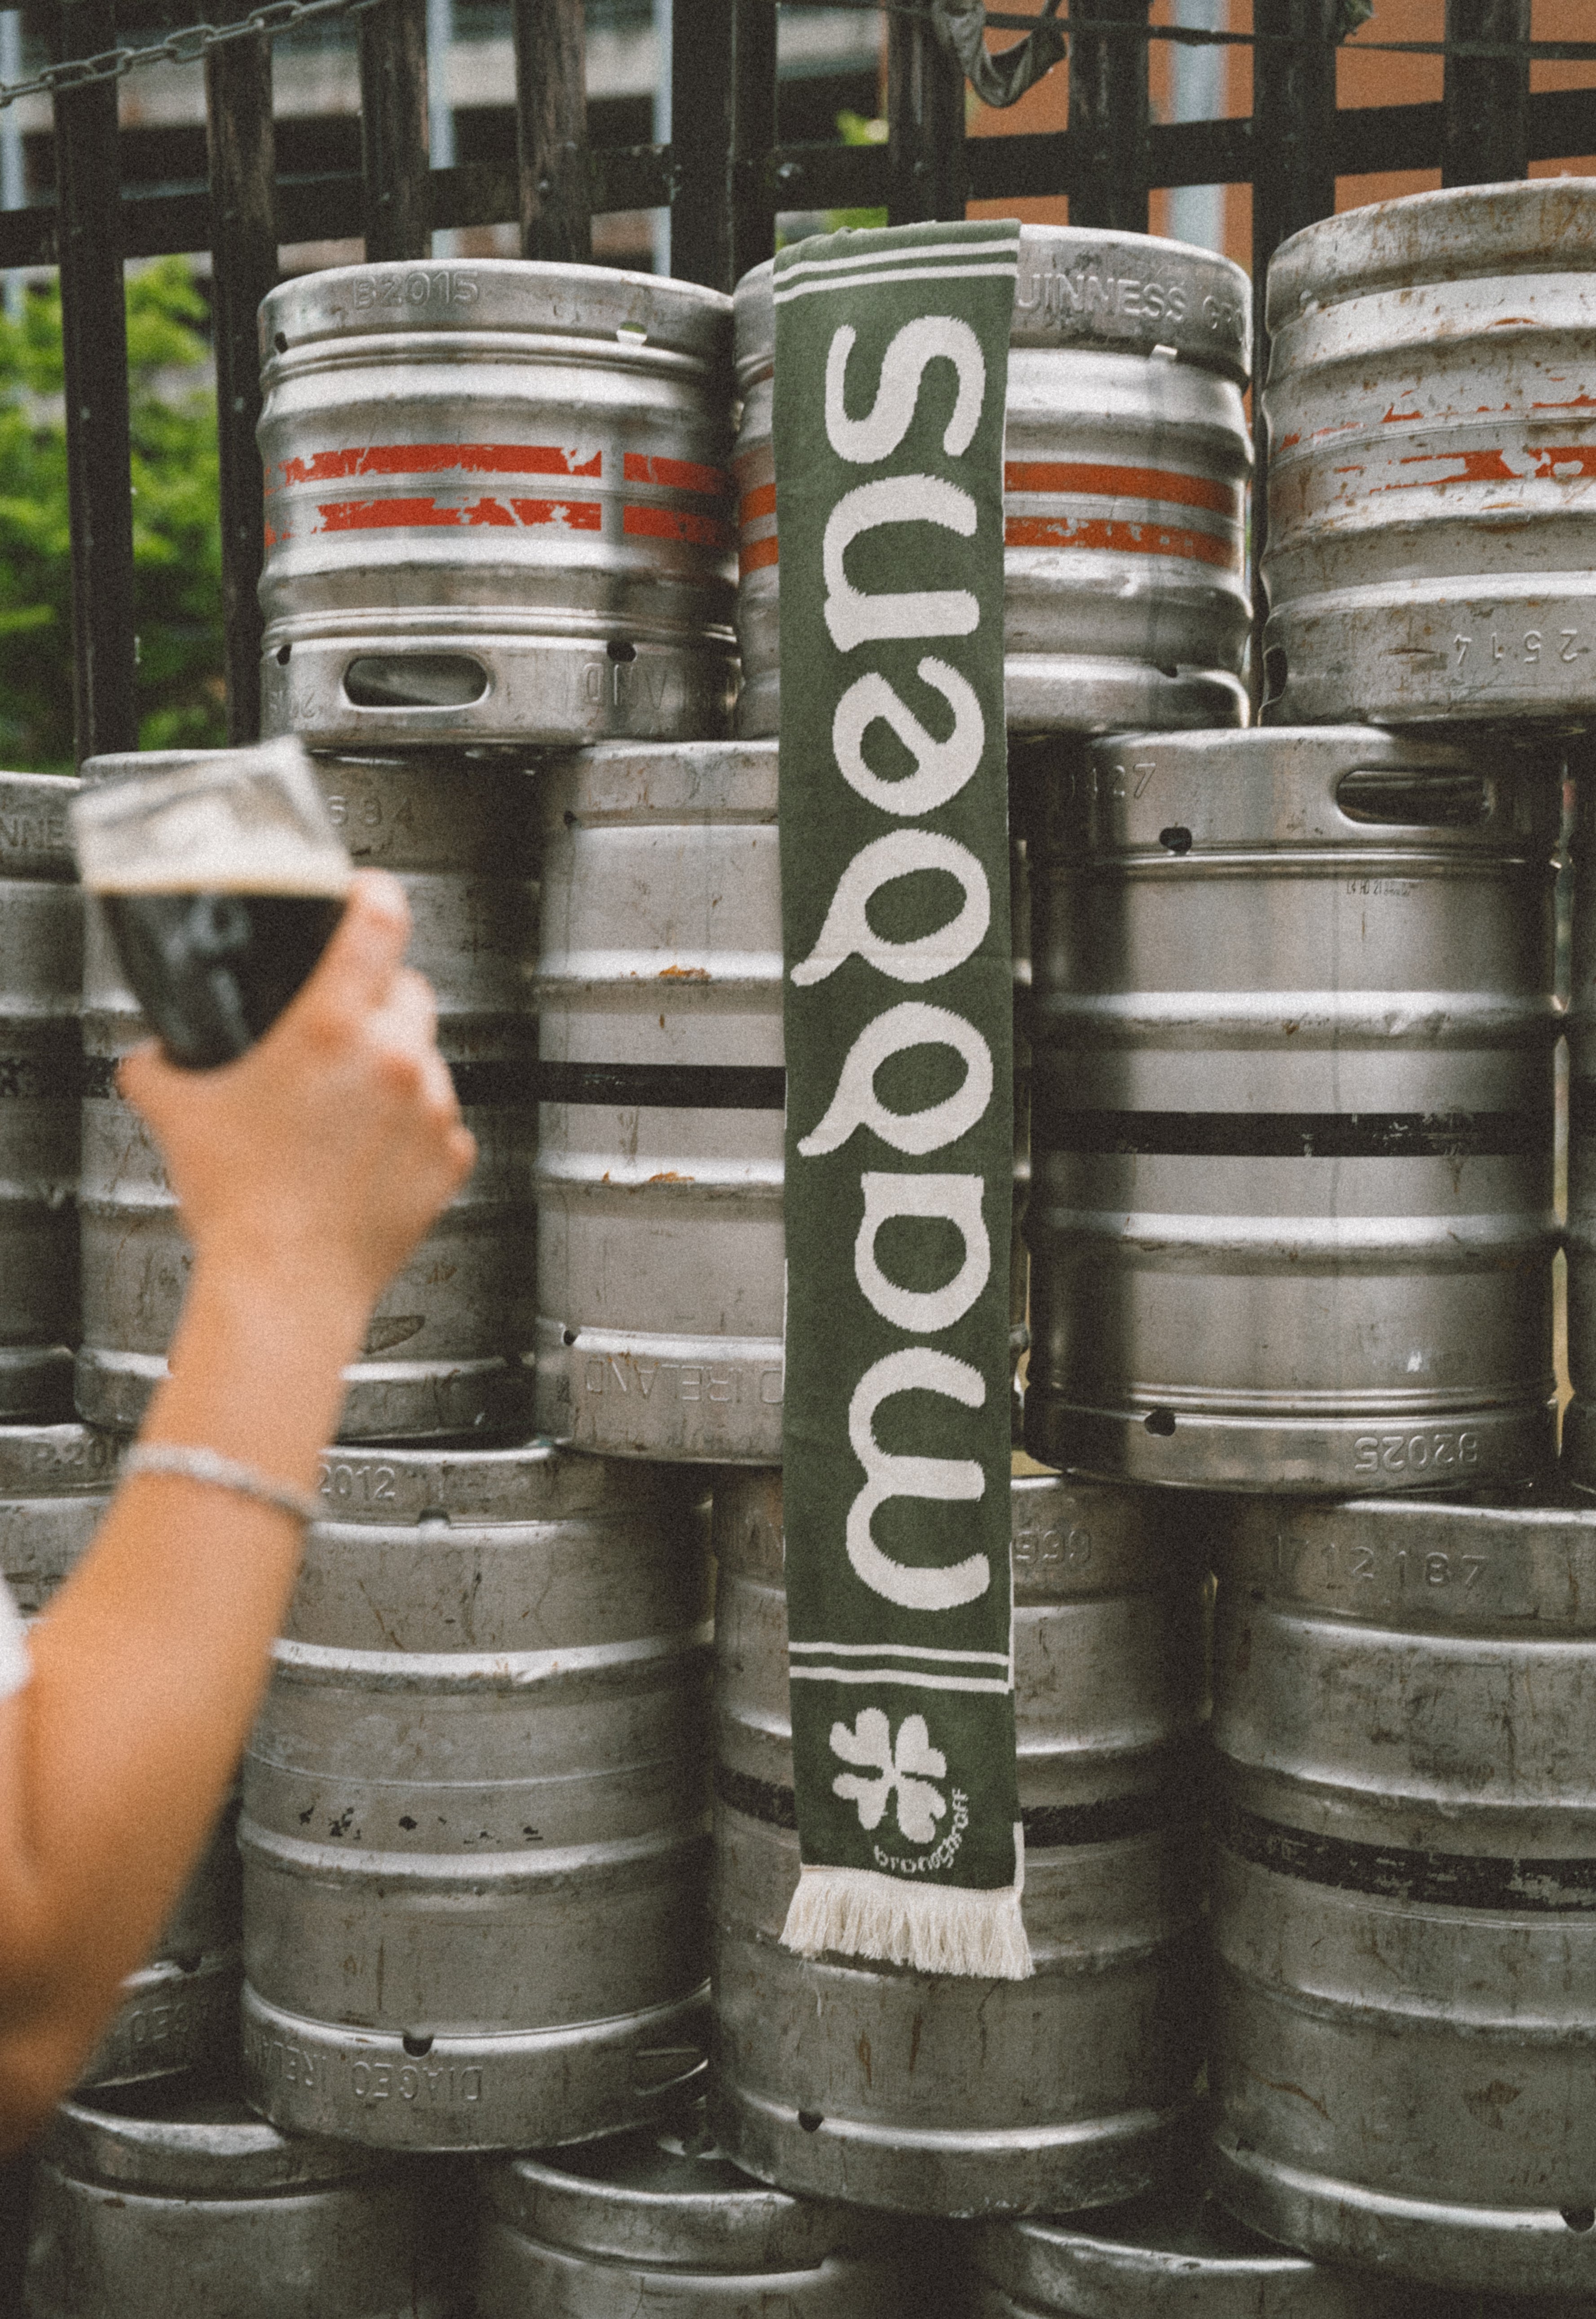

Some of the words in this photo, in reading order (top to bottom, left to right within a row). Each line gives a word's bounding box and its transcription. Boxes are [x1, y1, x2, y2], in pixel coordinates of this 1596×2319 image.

[1014, 271, 1186, 322] UINNESS
[791, 314, 992, 1612] maddens
[352, 2060, 484, 2101] DIAGEO
